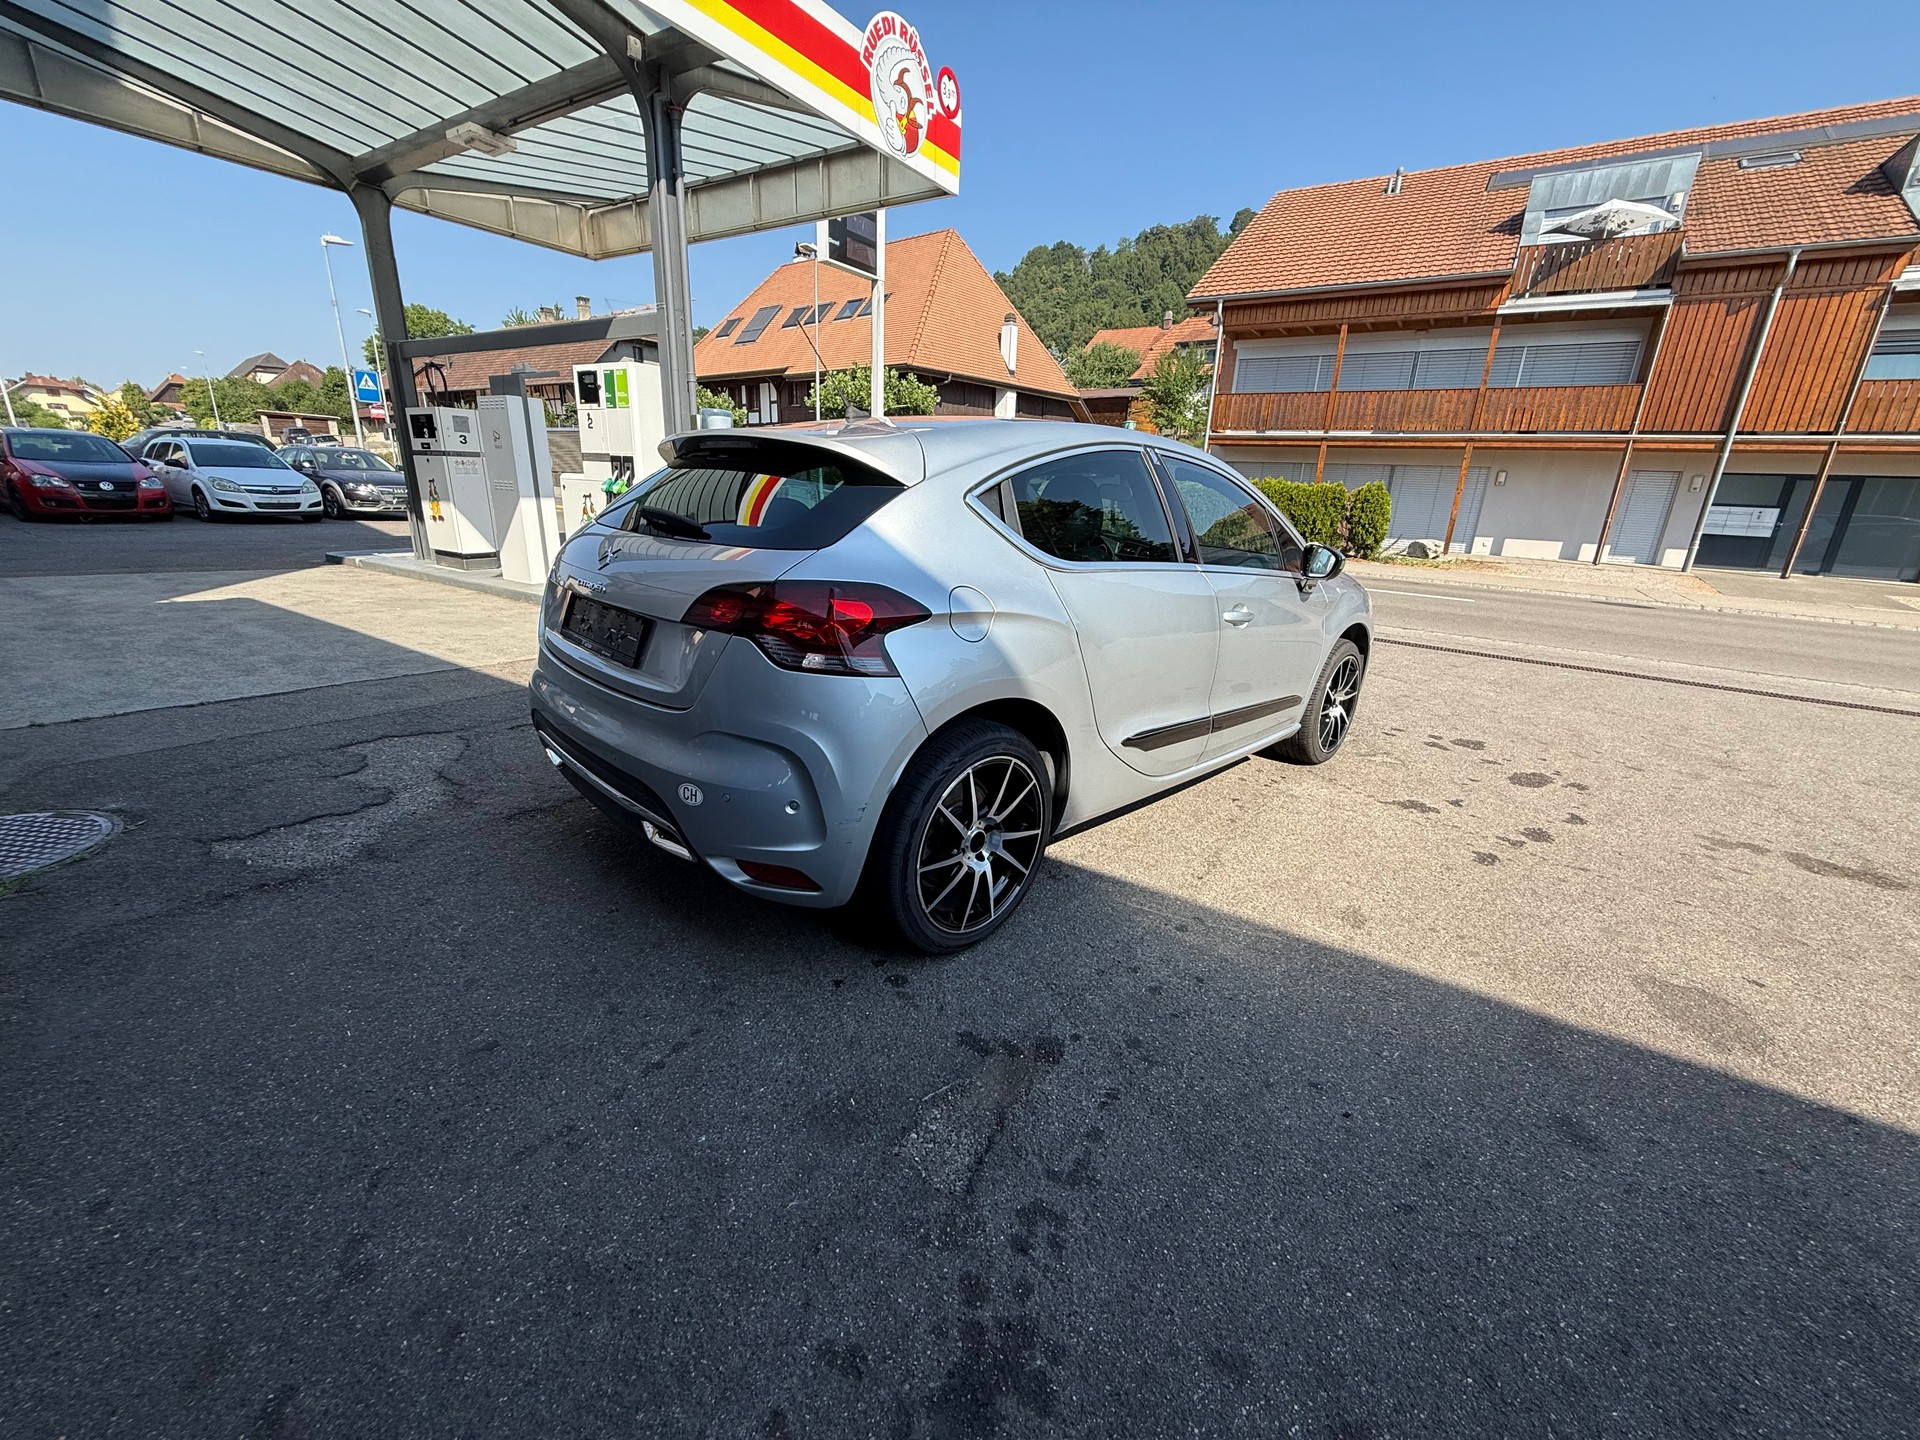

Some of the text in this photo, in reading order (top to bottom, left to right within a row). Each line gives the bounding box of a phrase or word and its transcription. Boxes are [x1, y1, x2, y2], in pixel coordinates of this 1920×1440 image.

[862, 16, 935, 120] RUEDI RÜSSEL
[423, 428, 429, 438] 3
[459, 434, 468, 445] 3
[683, 786, 698, 802] CH
